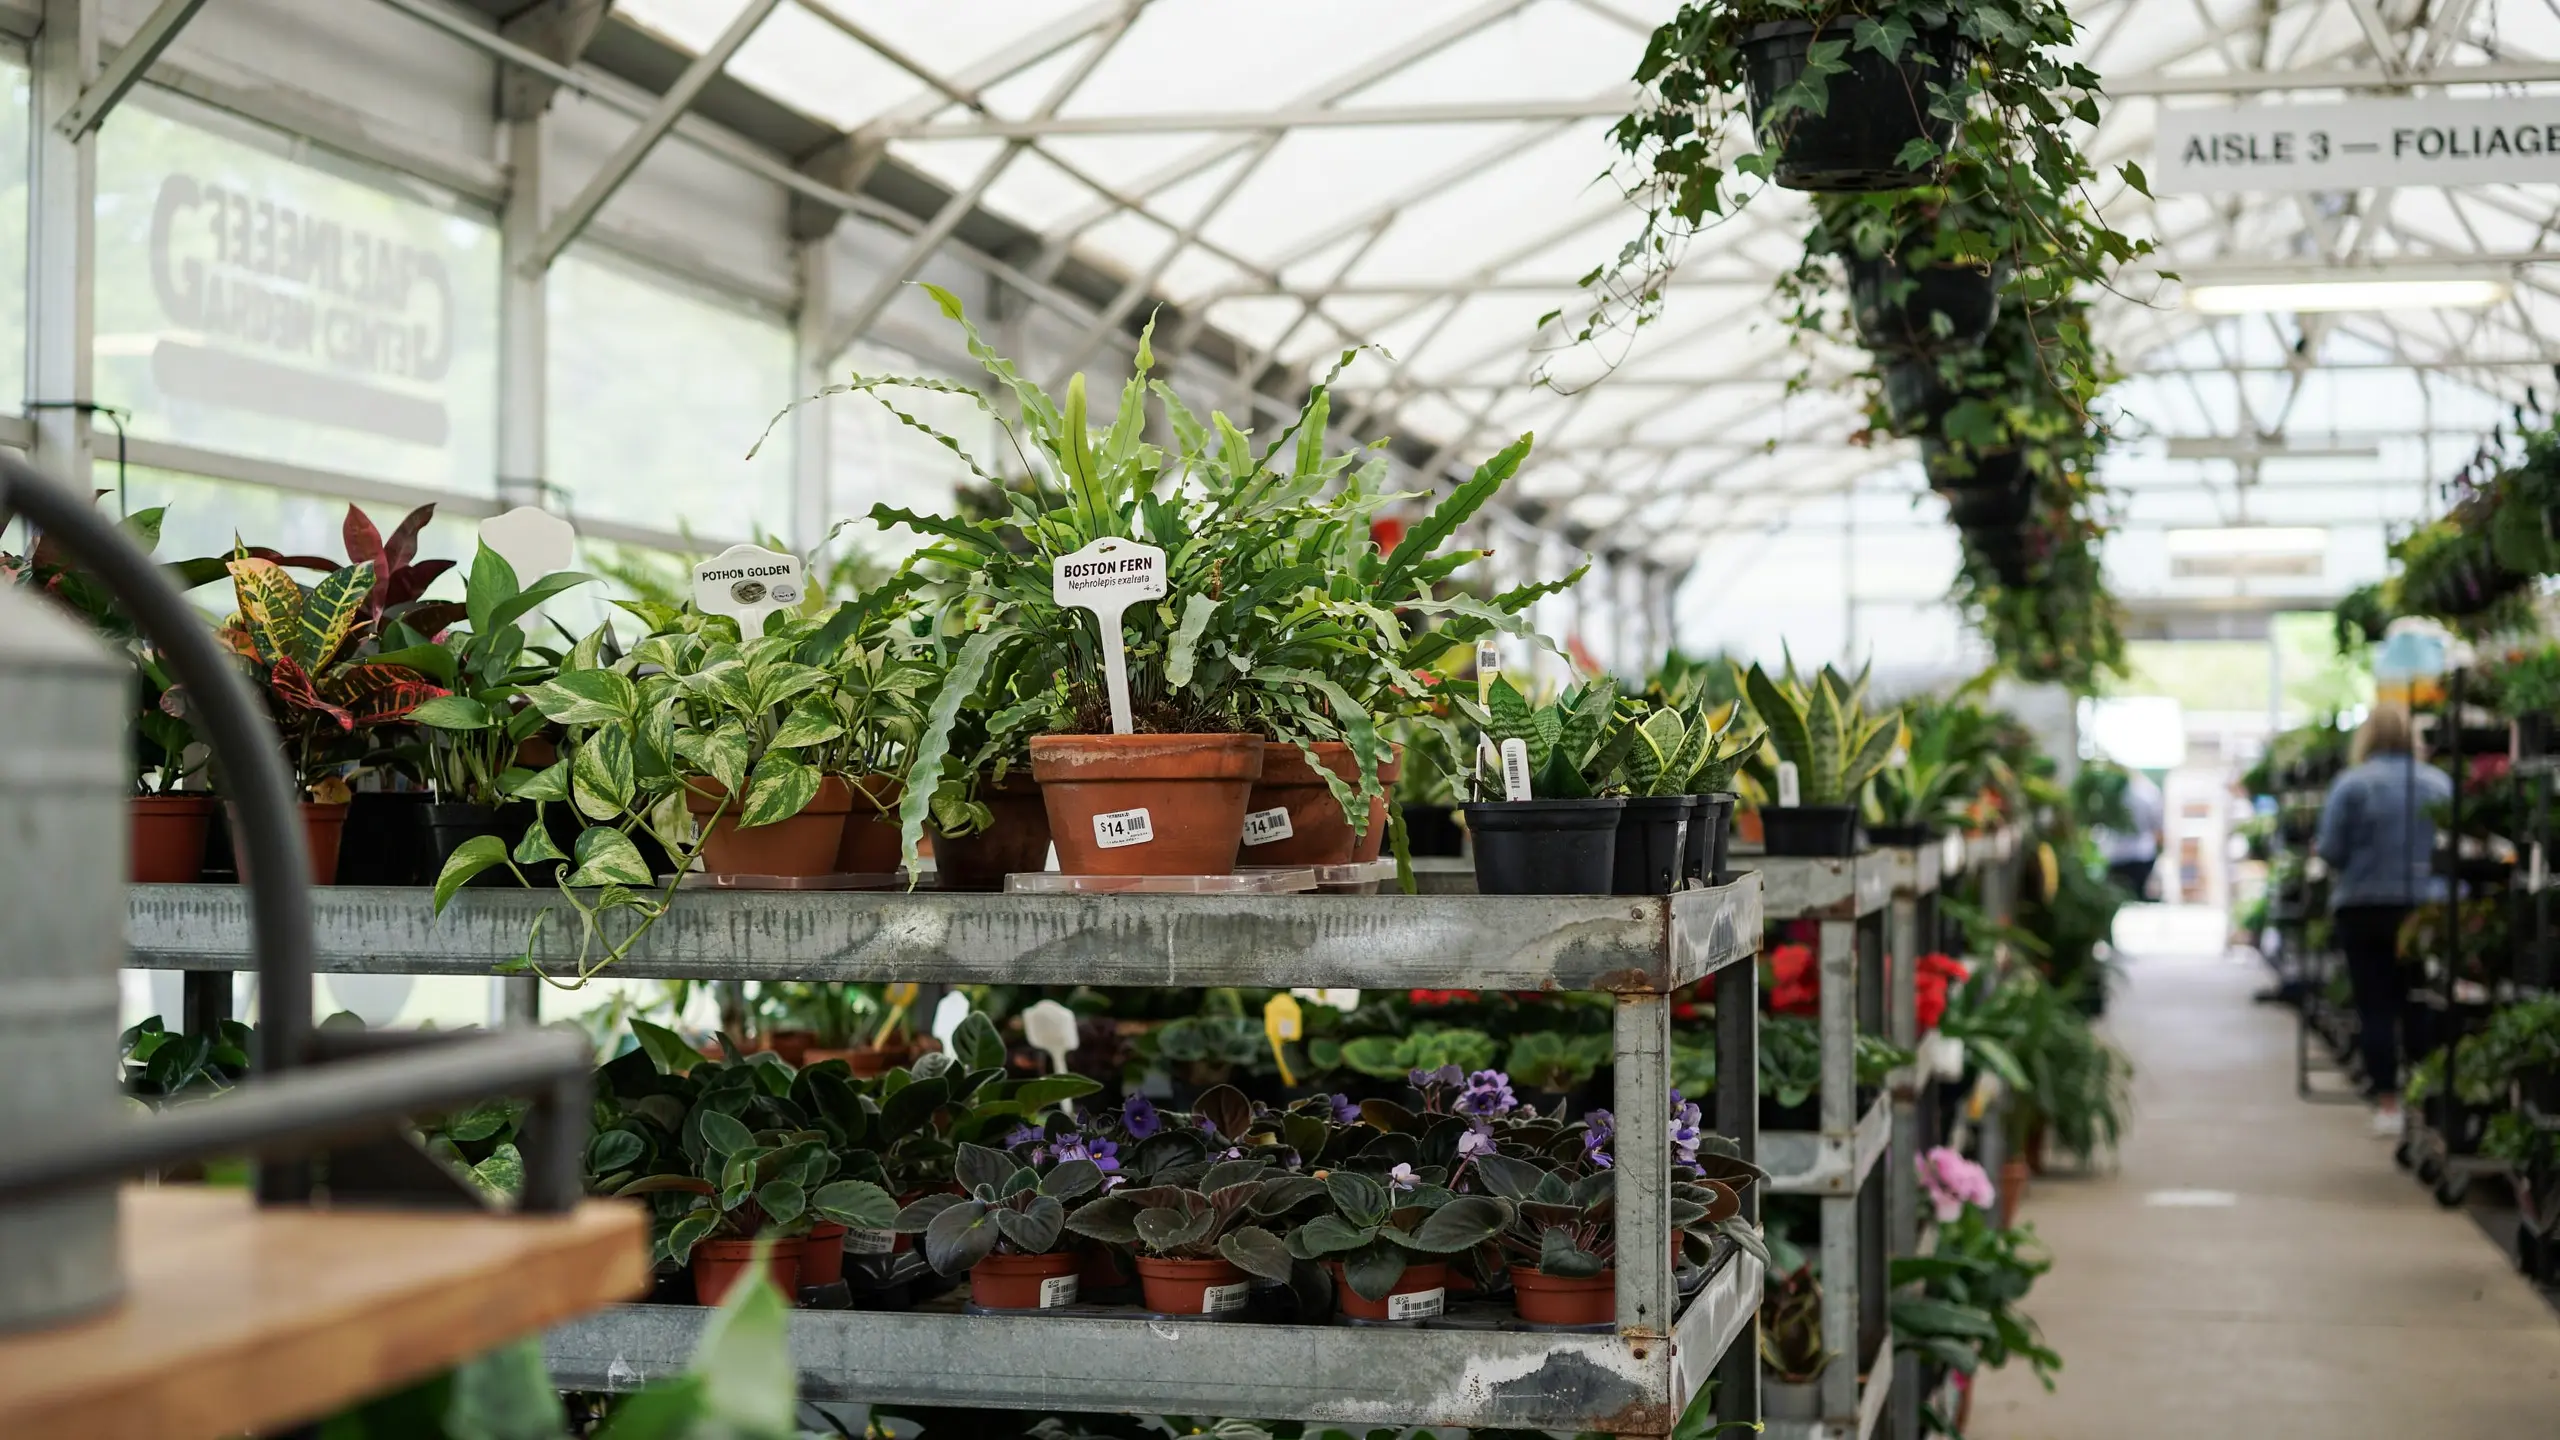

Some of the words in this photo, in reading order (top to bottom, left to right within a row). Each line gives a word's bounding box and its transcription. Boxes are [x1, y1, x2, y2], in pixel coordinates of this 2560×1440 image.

[2183, 131, 2295, 166] AISLE
[2307, 129, 2331, 163] 3
[2392, 123, 2560, 160] FOLIAGE
[747, 564, 791, 577] GOLDEN
[1064, 561, 1116, 578] BOSTON
[1120, 557, 1152, 572] FERN
[1068, 577, 1116, 591] Nephrolepis
